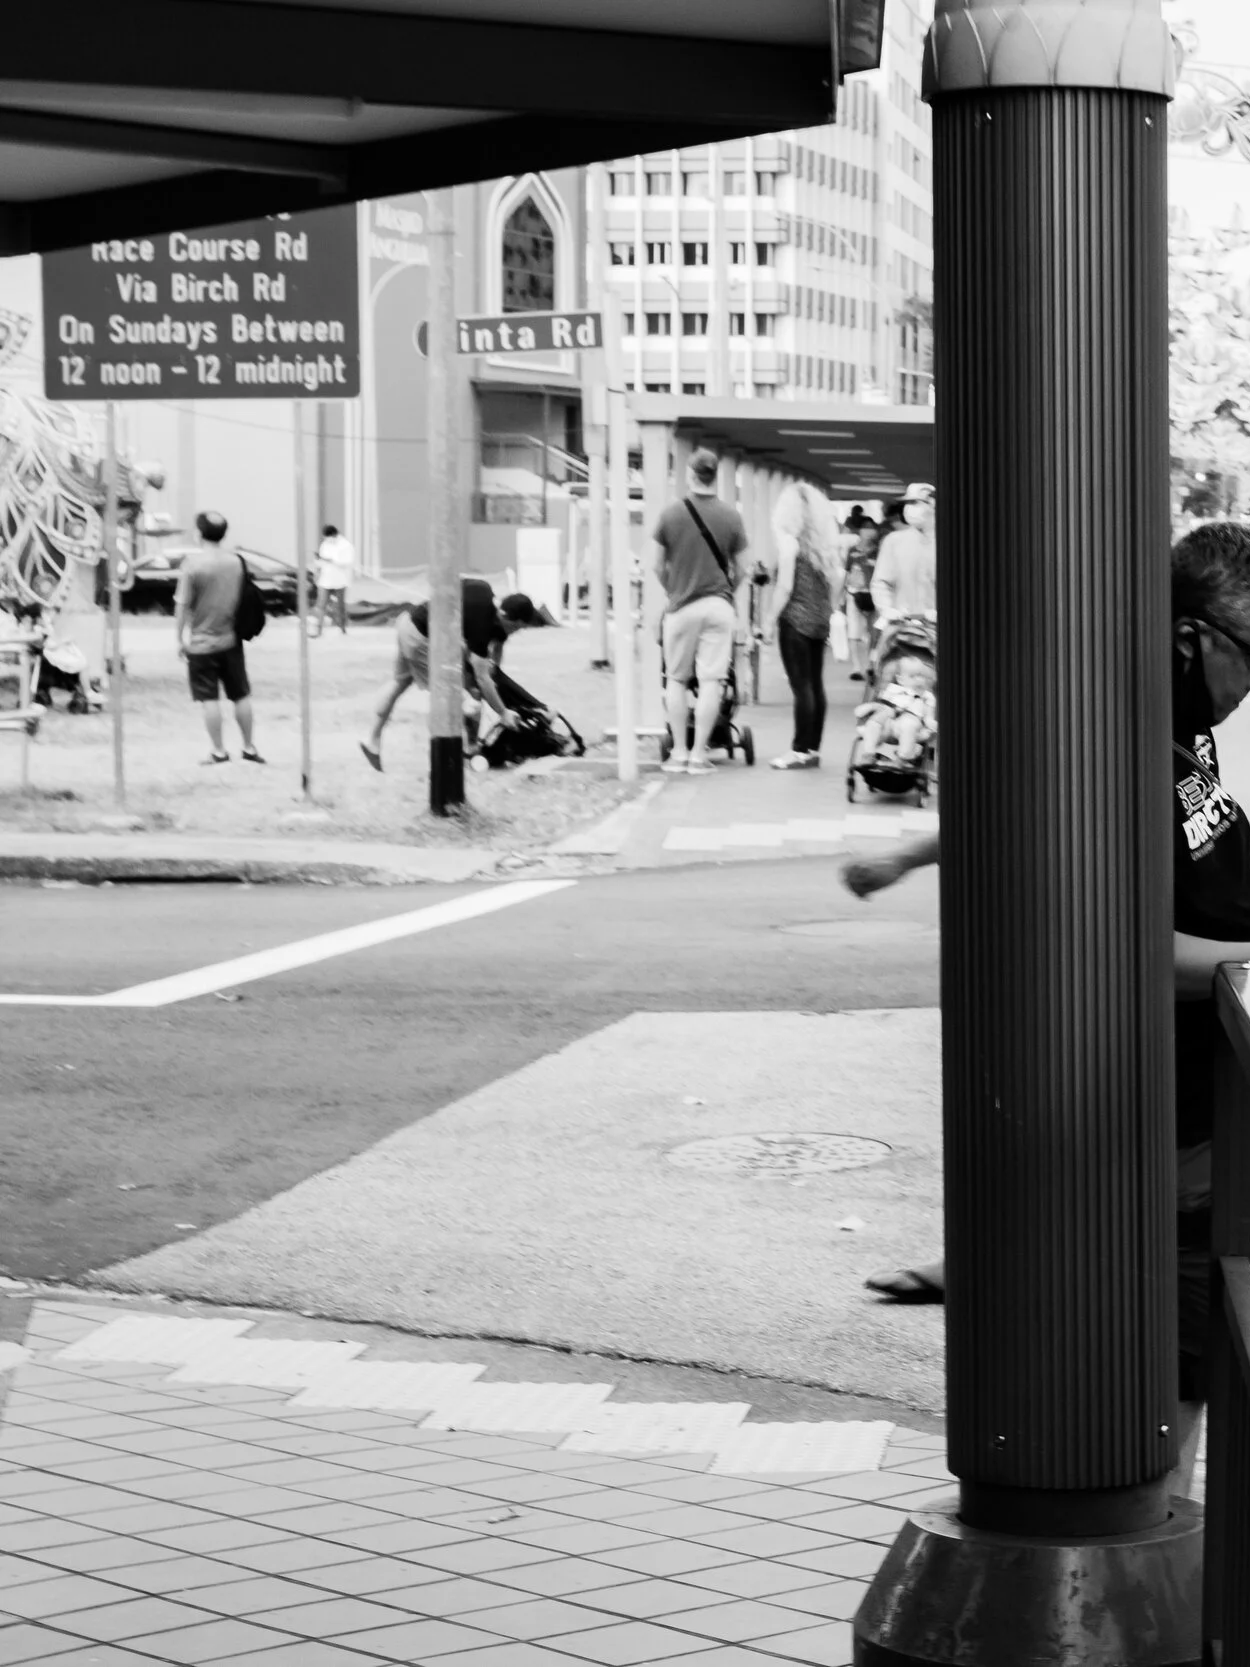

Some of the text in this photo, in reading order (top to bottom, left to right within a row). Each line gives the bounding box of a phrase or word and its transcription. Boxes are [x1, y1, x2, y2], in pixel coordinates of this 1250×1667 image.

[168, 232, 261, 262] Course
[274, 231, 308, 261] Rd
[116, 272, 286, 303] Via Birch Rd
[59, 313, 345, 351] On Sundays Between
[459, 315, 596, 352] inta Rd
[59, 355, 86, 385] 12
[100, 361, 161, 385] noon
[195, 354, 221, 385] 12
[235, 353, 347, 391] midnight
